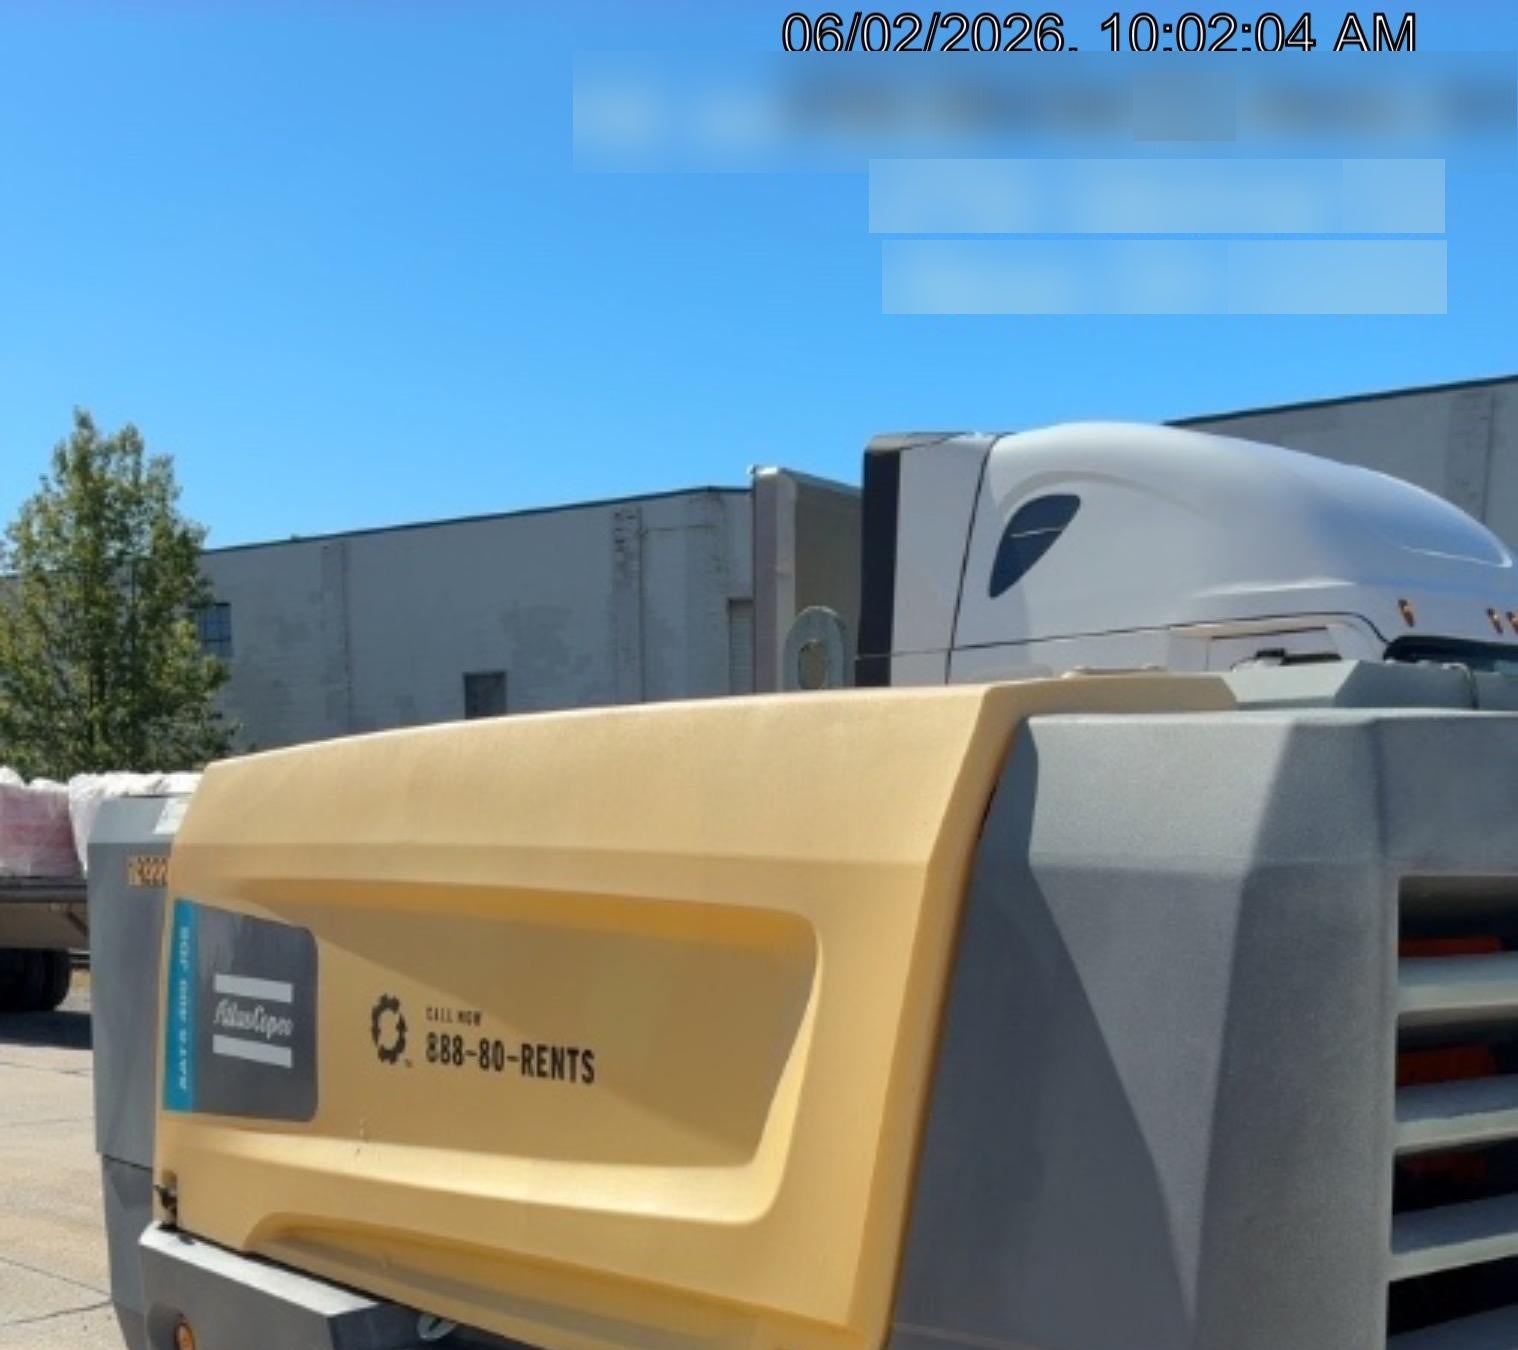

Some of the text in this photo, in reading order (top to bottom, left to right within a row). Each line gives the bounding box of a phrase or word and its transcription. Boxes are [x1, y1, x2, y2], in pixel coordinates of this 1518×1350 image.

[426, 1007, 482, 1026] CALL NOW
[426, 1031, 596, 1085] 888-80-RENTS
